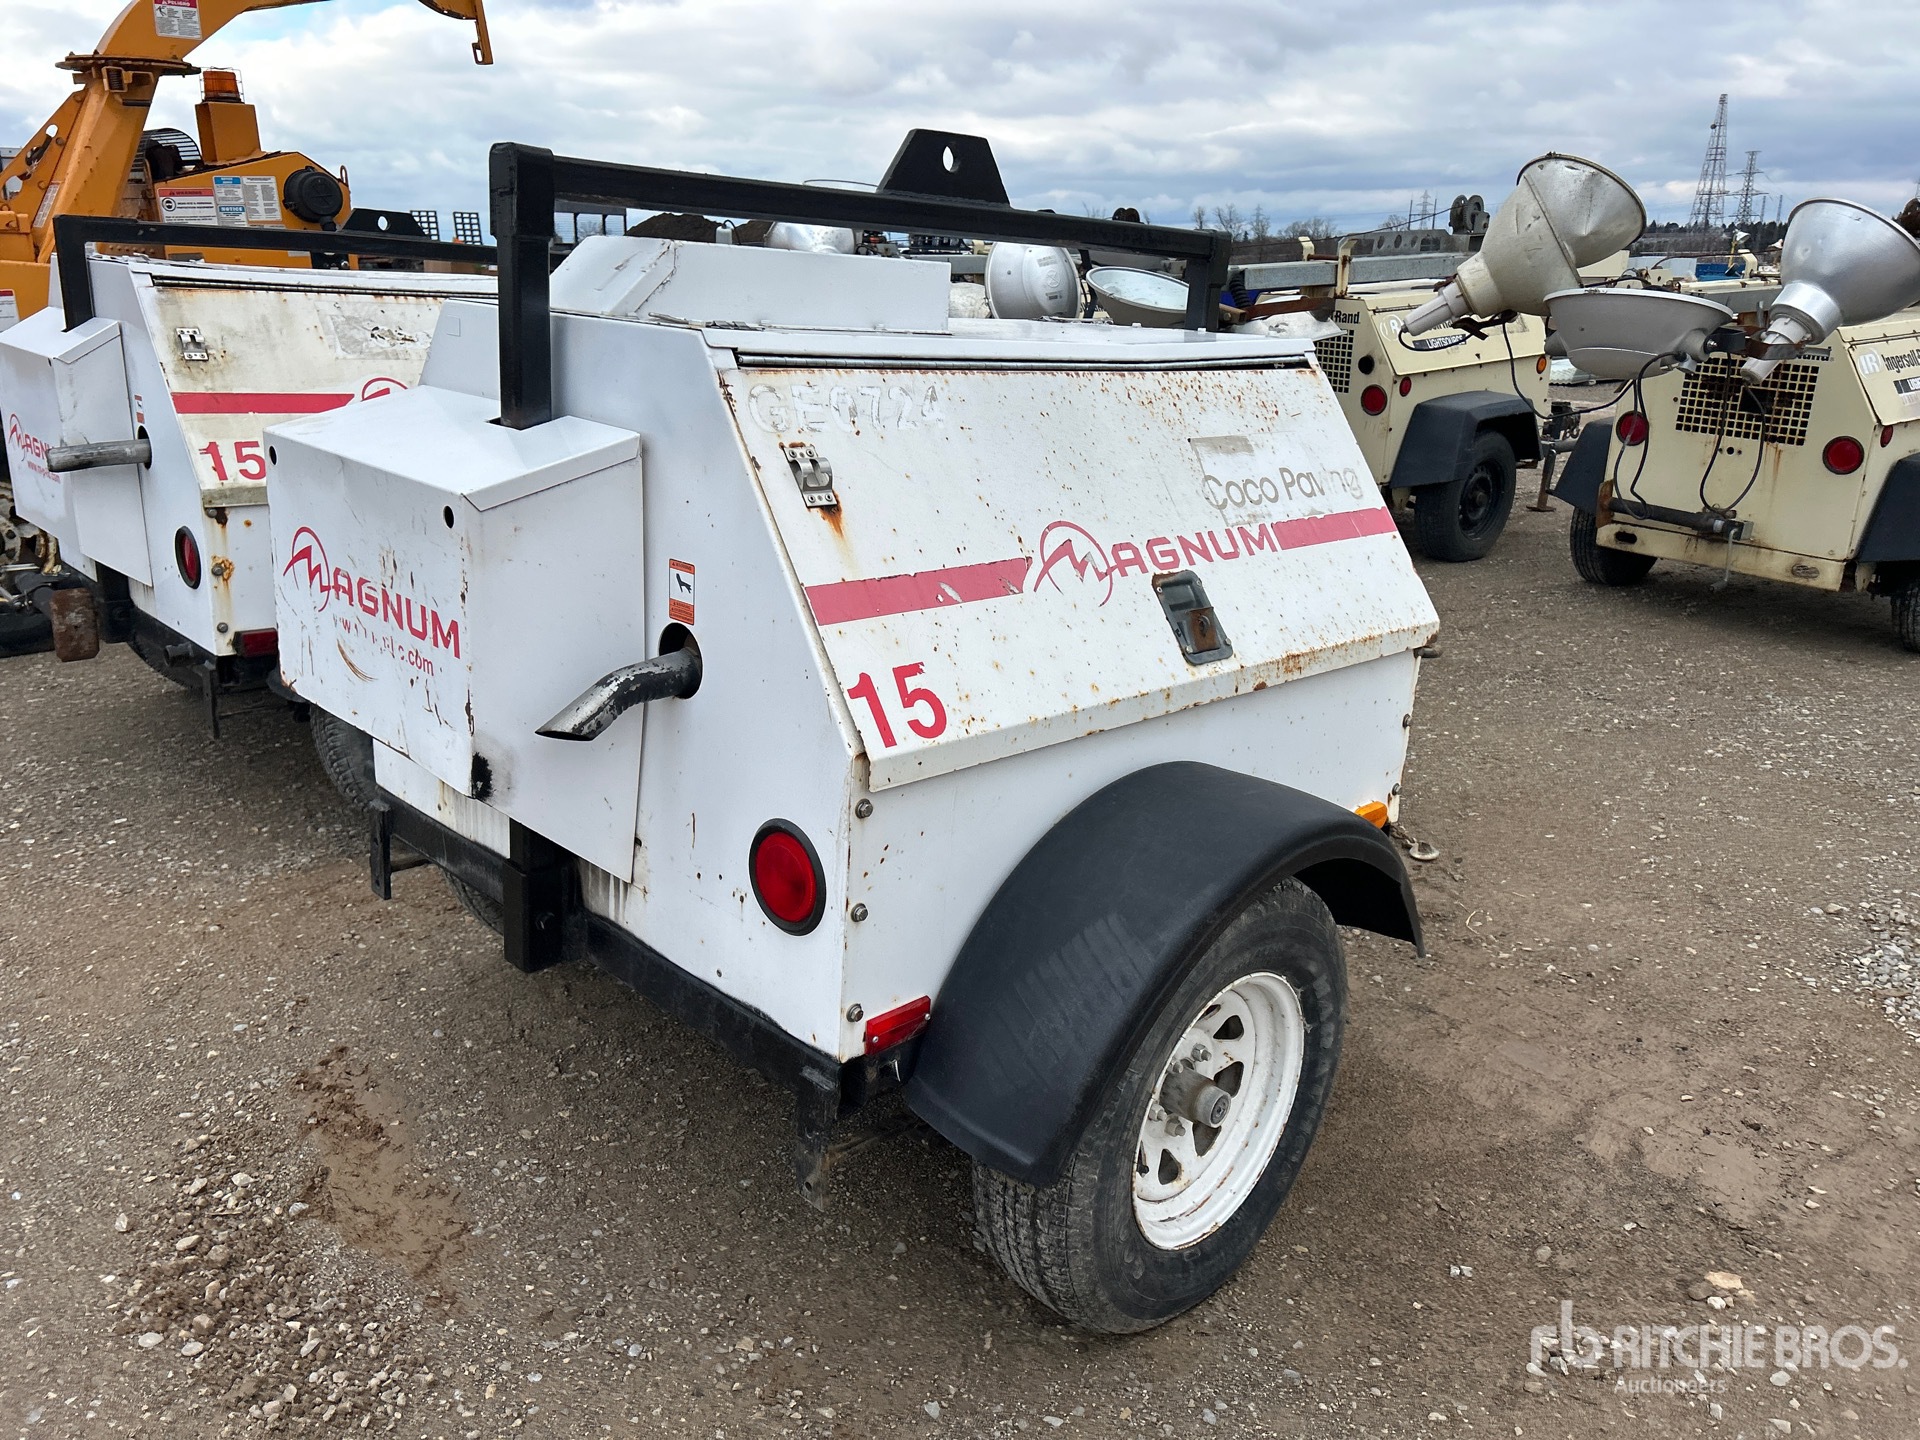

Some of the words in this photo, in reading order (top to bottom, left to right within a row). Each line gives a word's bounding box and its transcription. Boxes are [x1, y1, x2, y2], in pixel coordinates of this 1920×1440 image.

[199, 440, 266, 482] 15
[1202, 474, 1280, 511] Coco
[282, 526, 461, 660] MAGNUM
[1034, 520, 1278, 608] MAGNUM
[847, 661, 948, 749] 15
